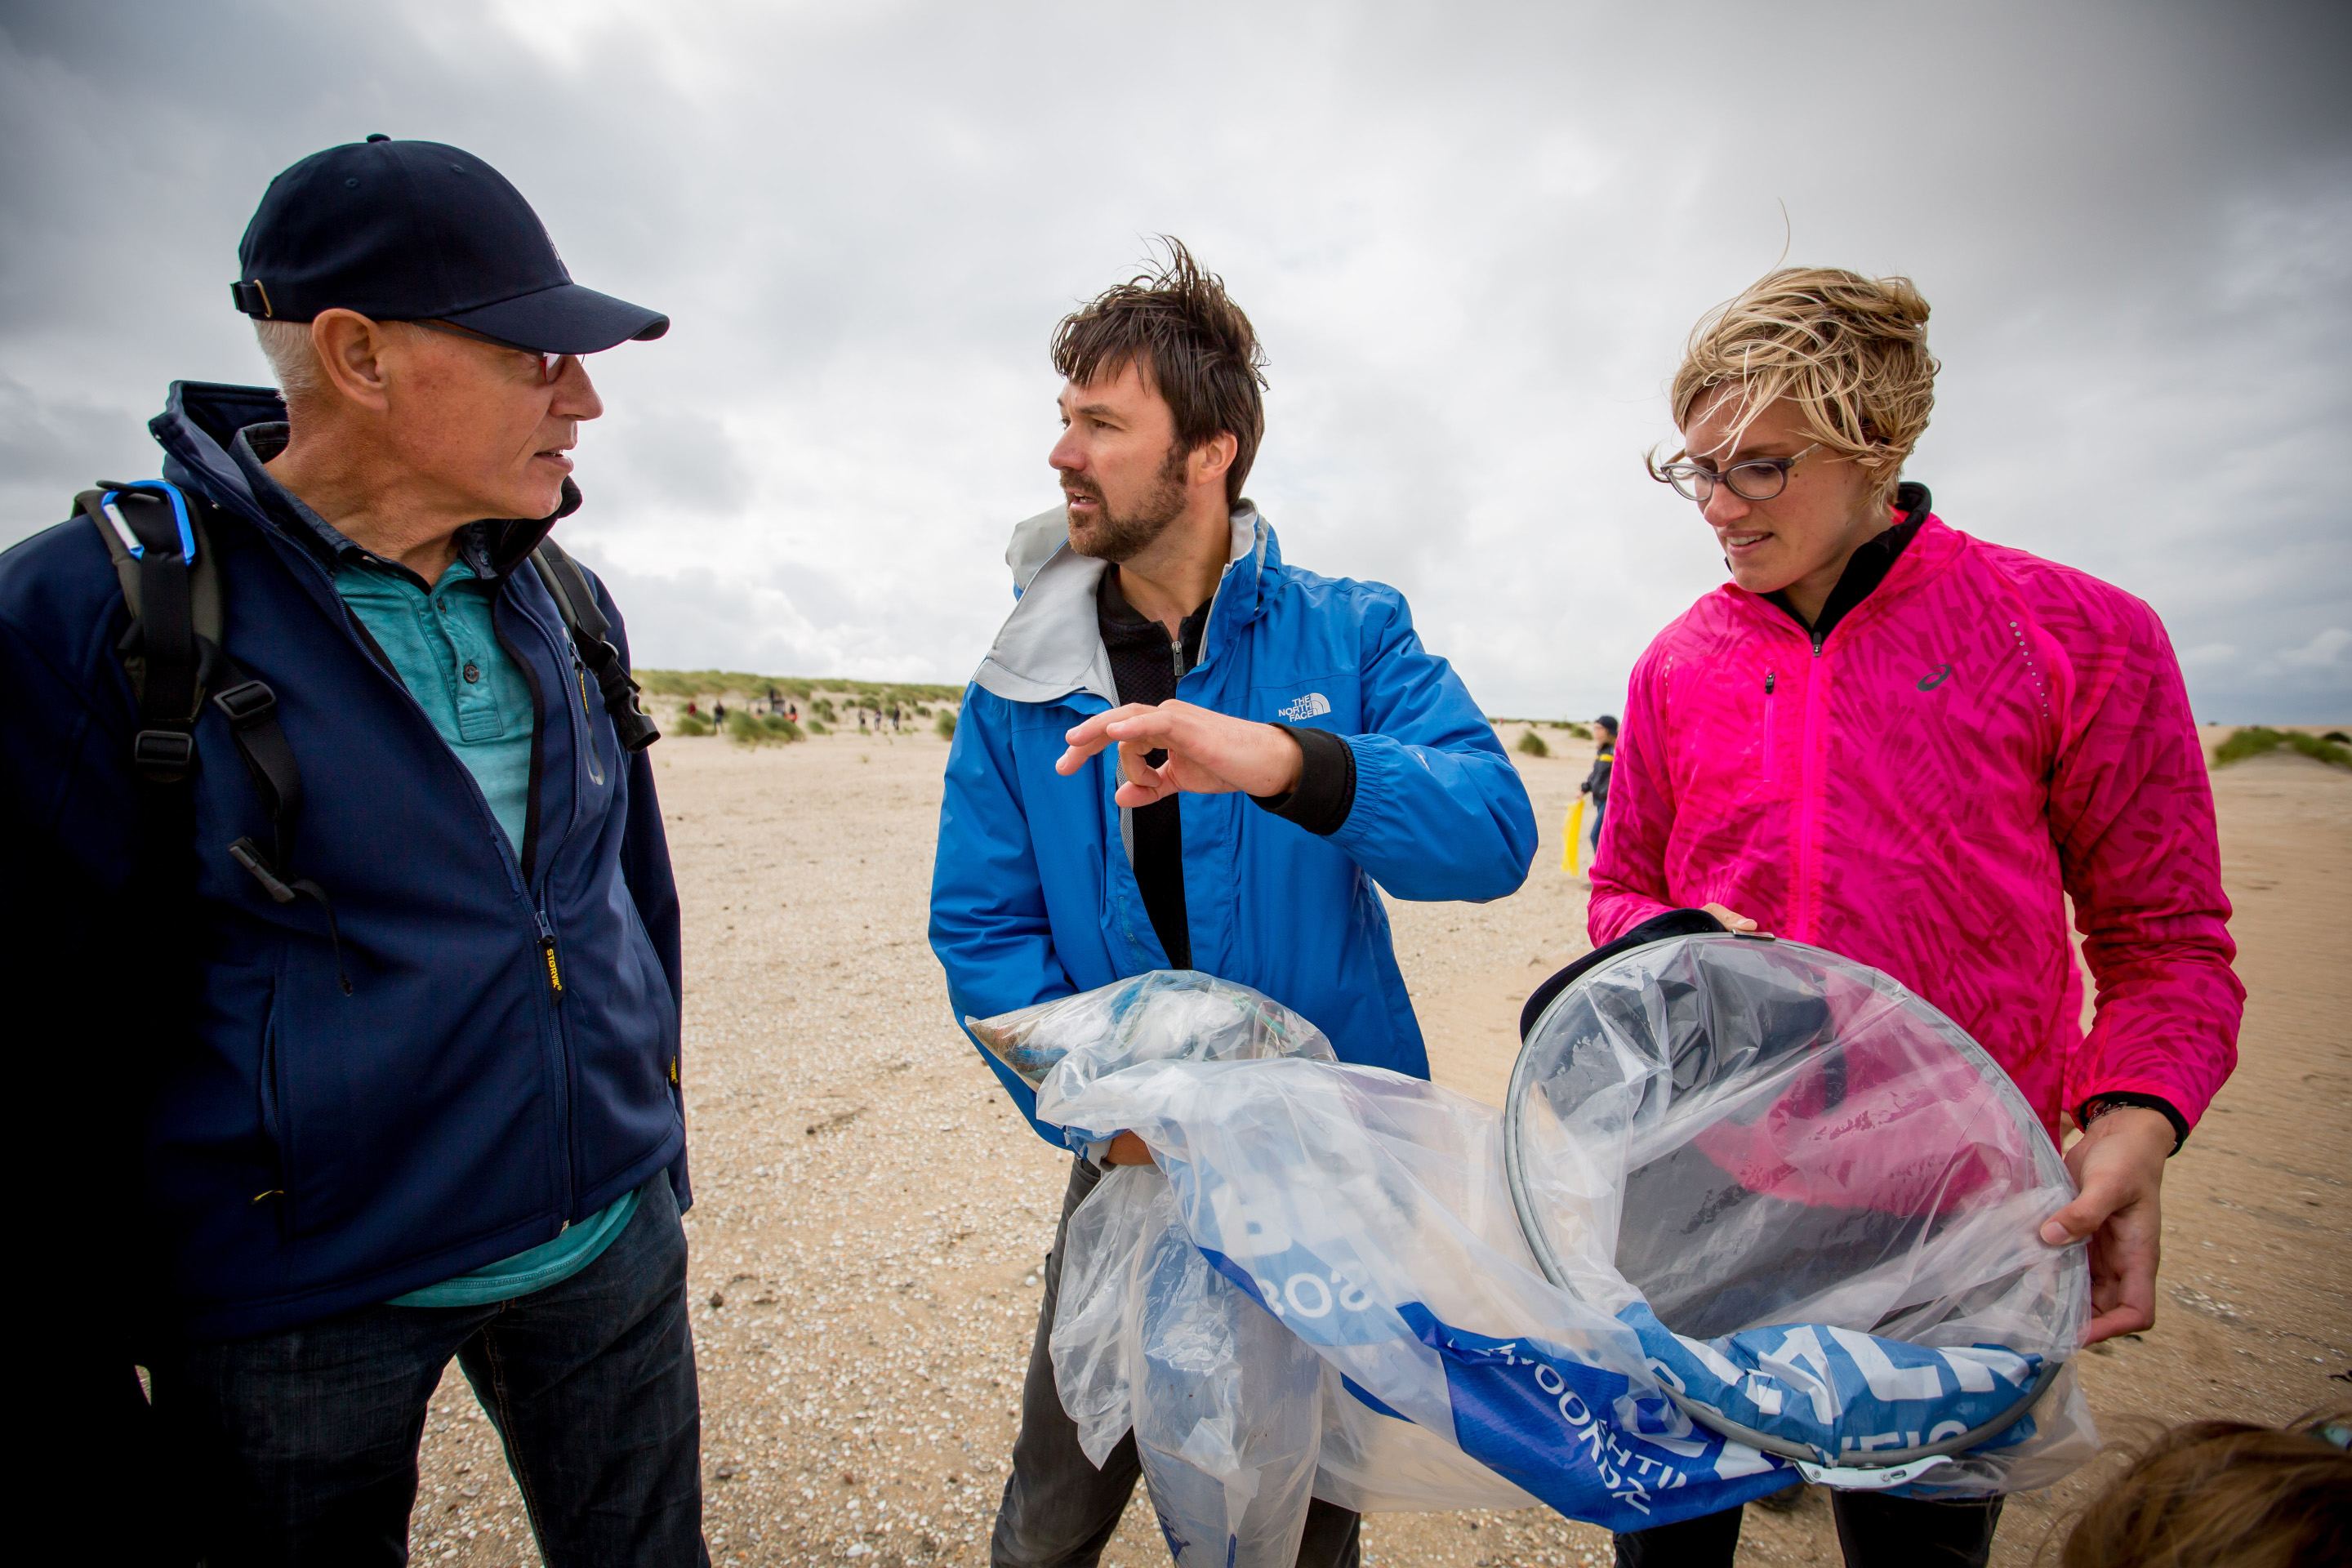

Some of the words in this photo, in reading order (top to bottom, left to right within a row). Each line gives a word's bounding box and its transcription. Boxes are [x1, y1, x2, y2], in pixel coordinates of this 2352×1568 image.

[1292, 694, 1311, 706] THE
[1278, 702, 1312, 717] NORTH
[1289, 710, 1314, 723] FACE
